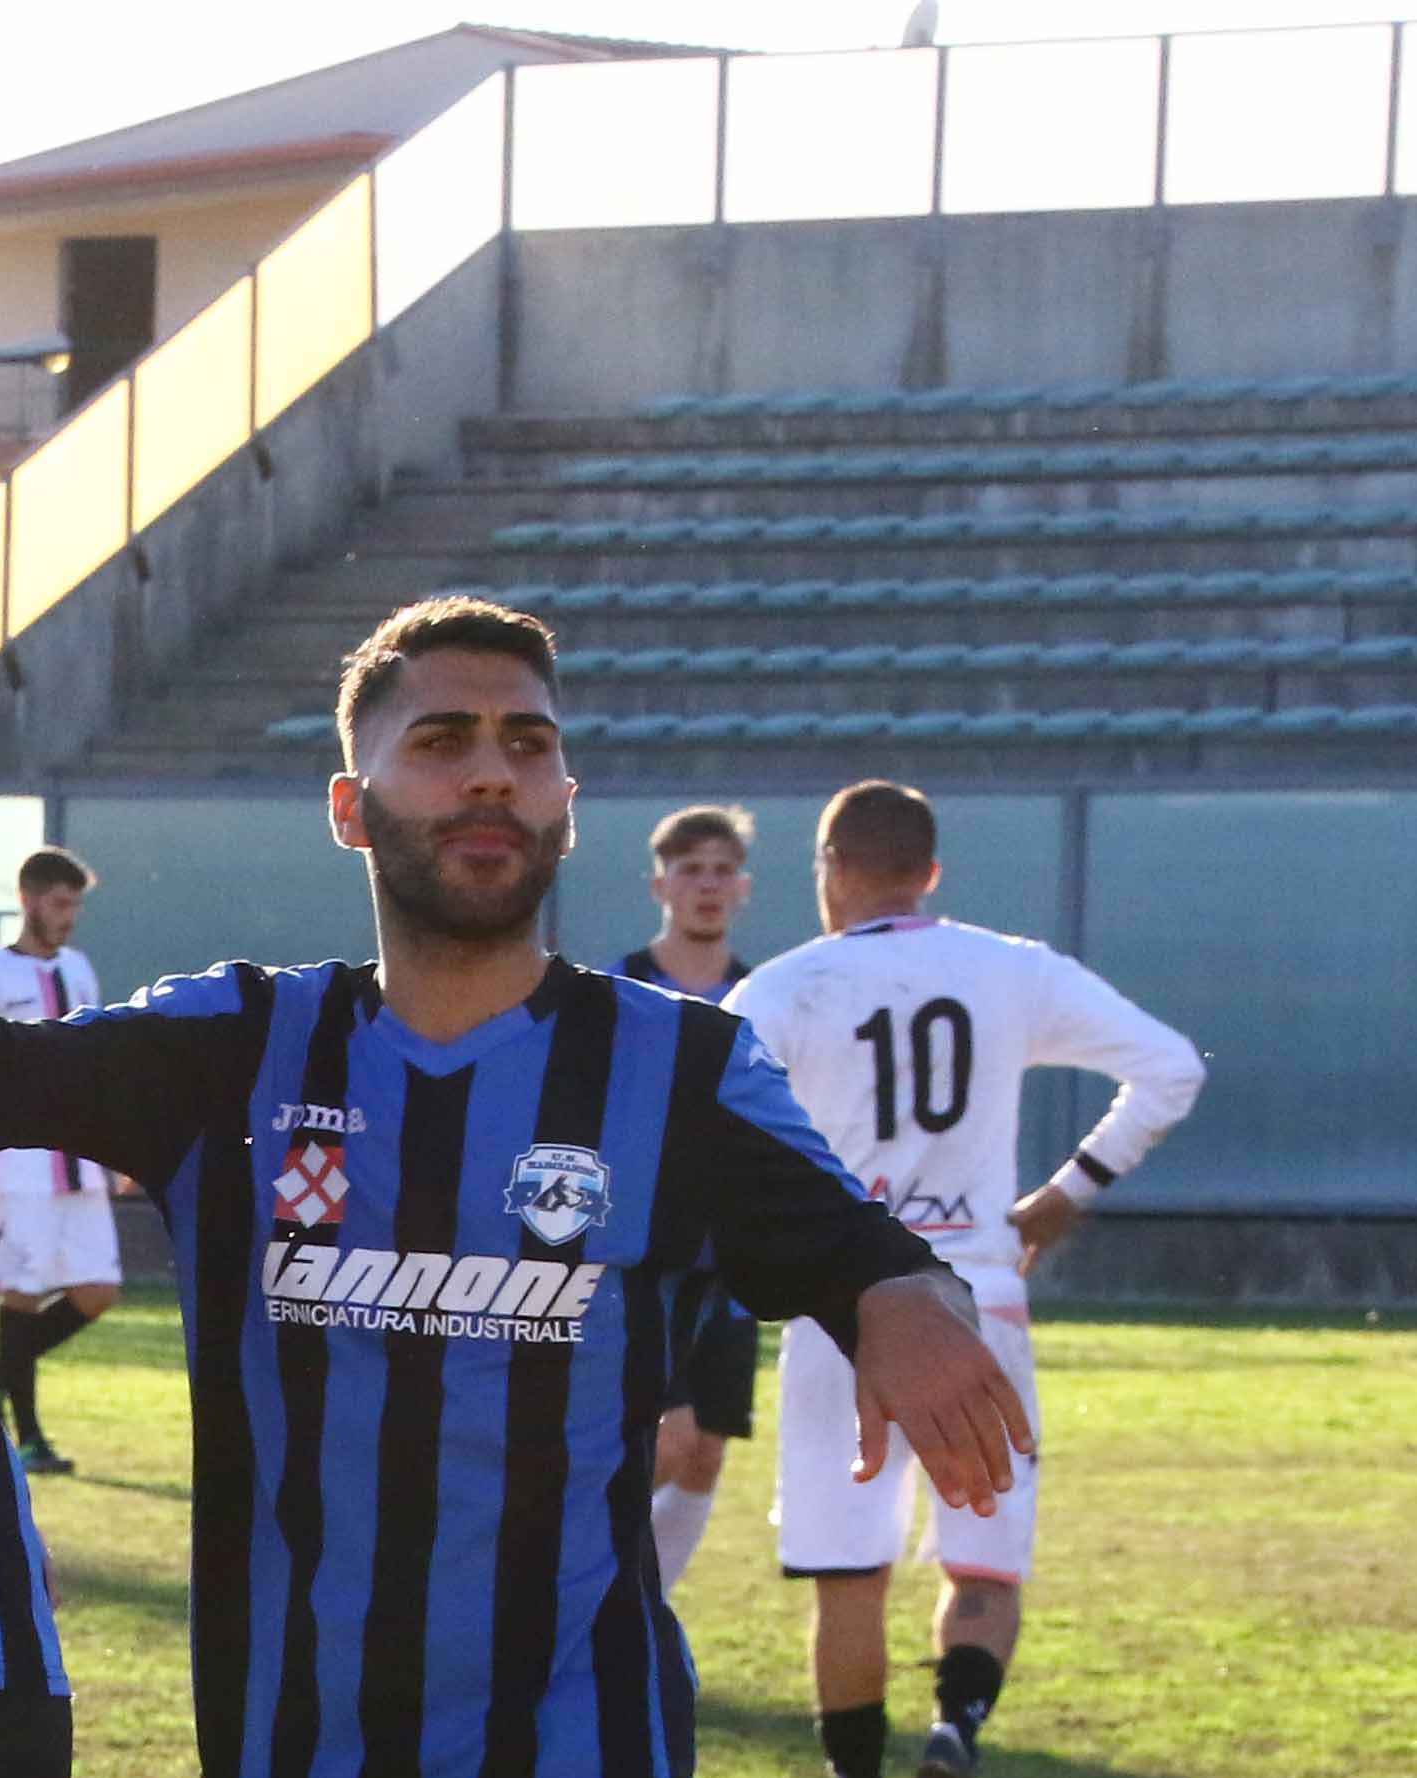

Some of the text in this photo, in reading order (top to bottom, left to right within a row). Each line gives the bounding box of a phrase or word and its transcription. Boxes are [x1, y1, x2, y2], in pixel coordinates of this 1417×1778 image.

[854, 996, 973, 1141] 10
[266, 1299, 585, 1343] ERNICIATURA INDUSTRIALE
